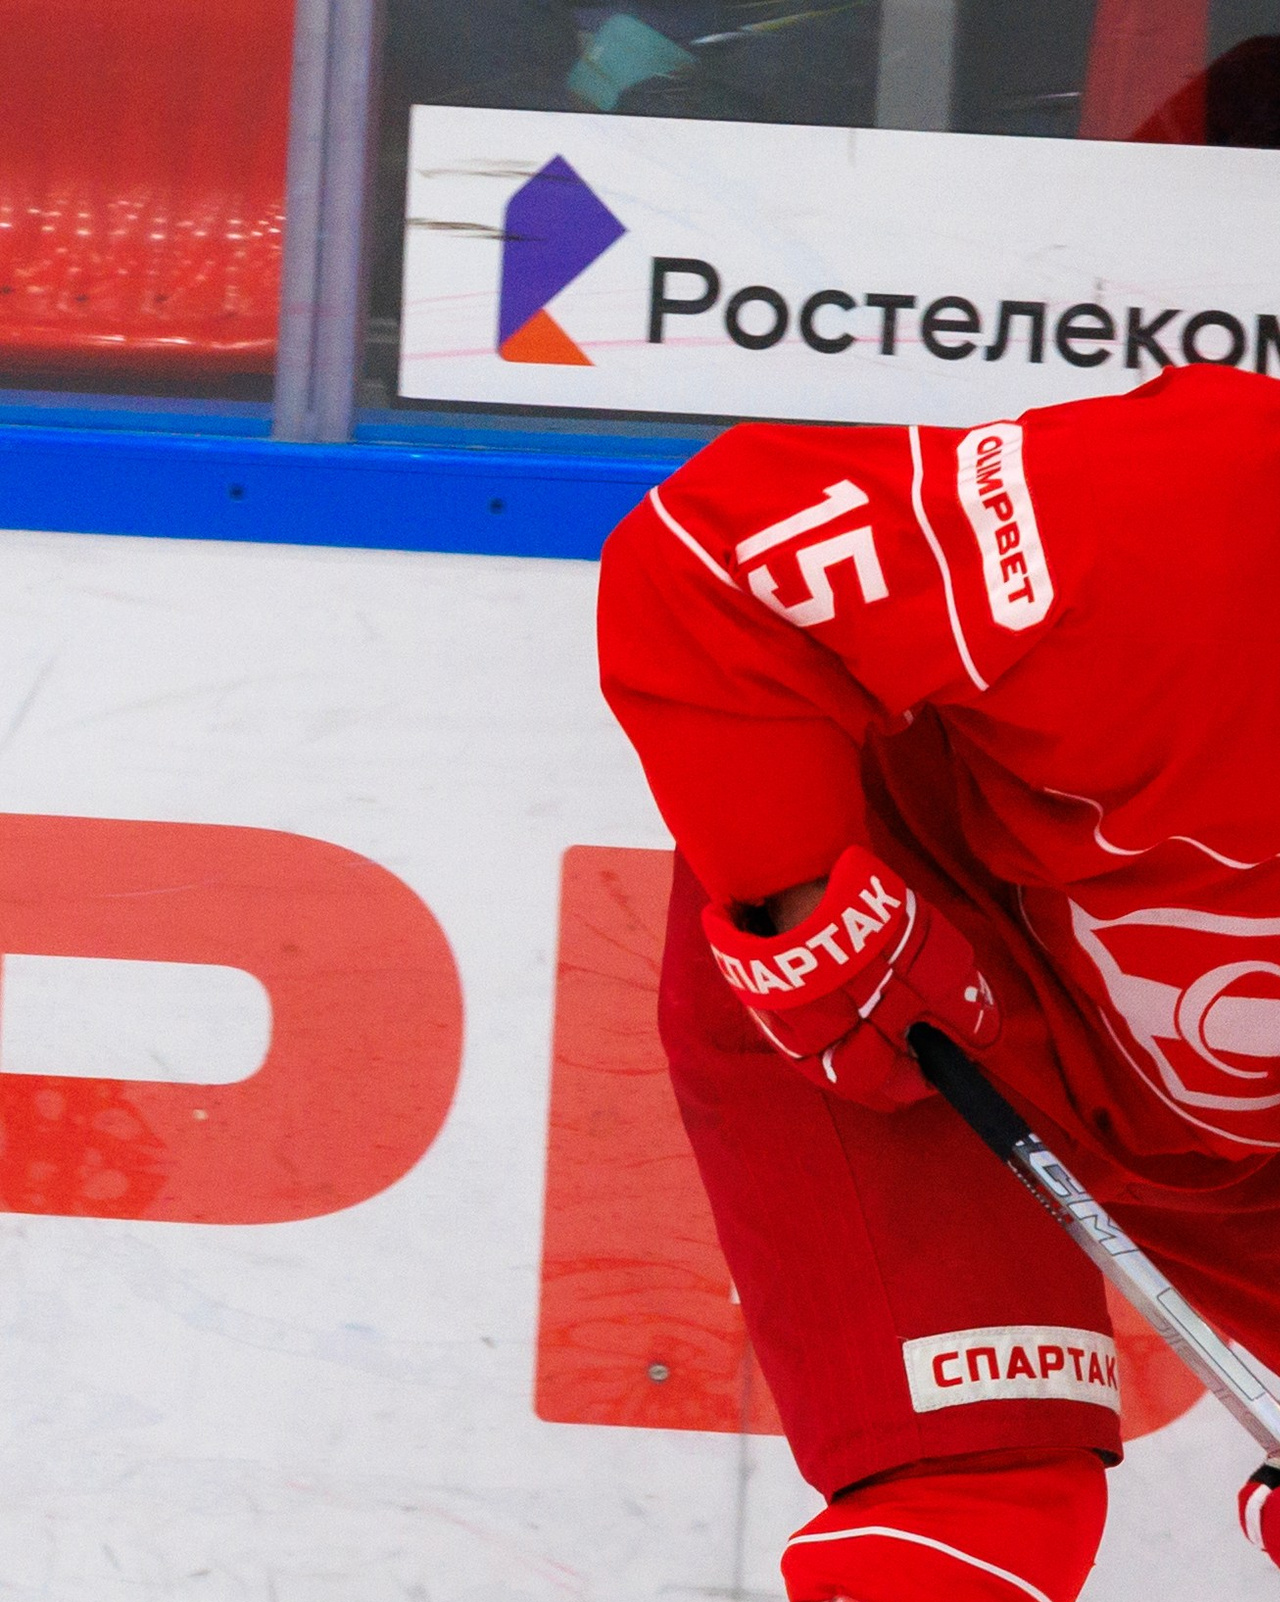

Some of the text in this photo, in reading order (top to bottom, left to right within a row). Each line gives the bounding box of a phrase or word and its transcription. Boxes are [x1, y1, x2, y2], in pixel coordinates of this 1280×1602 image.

[735, 479, 889, 628] 15
[976, 436, 1035, 604] OLIMPBET
[931, 1345, 1118, 1391] СПАРТАК
